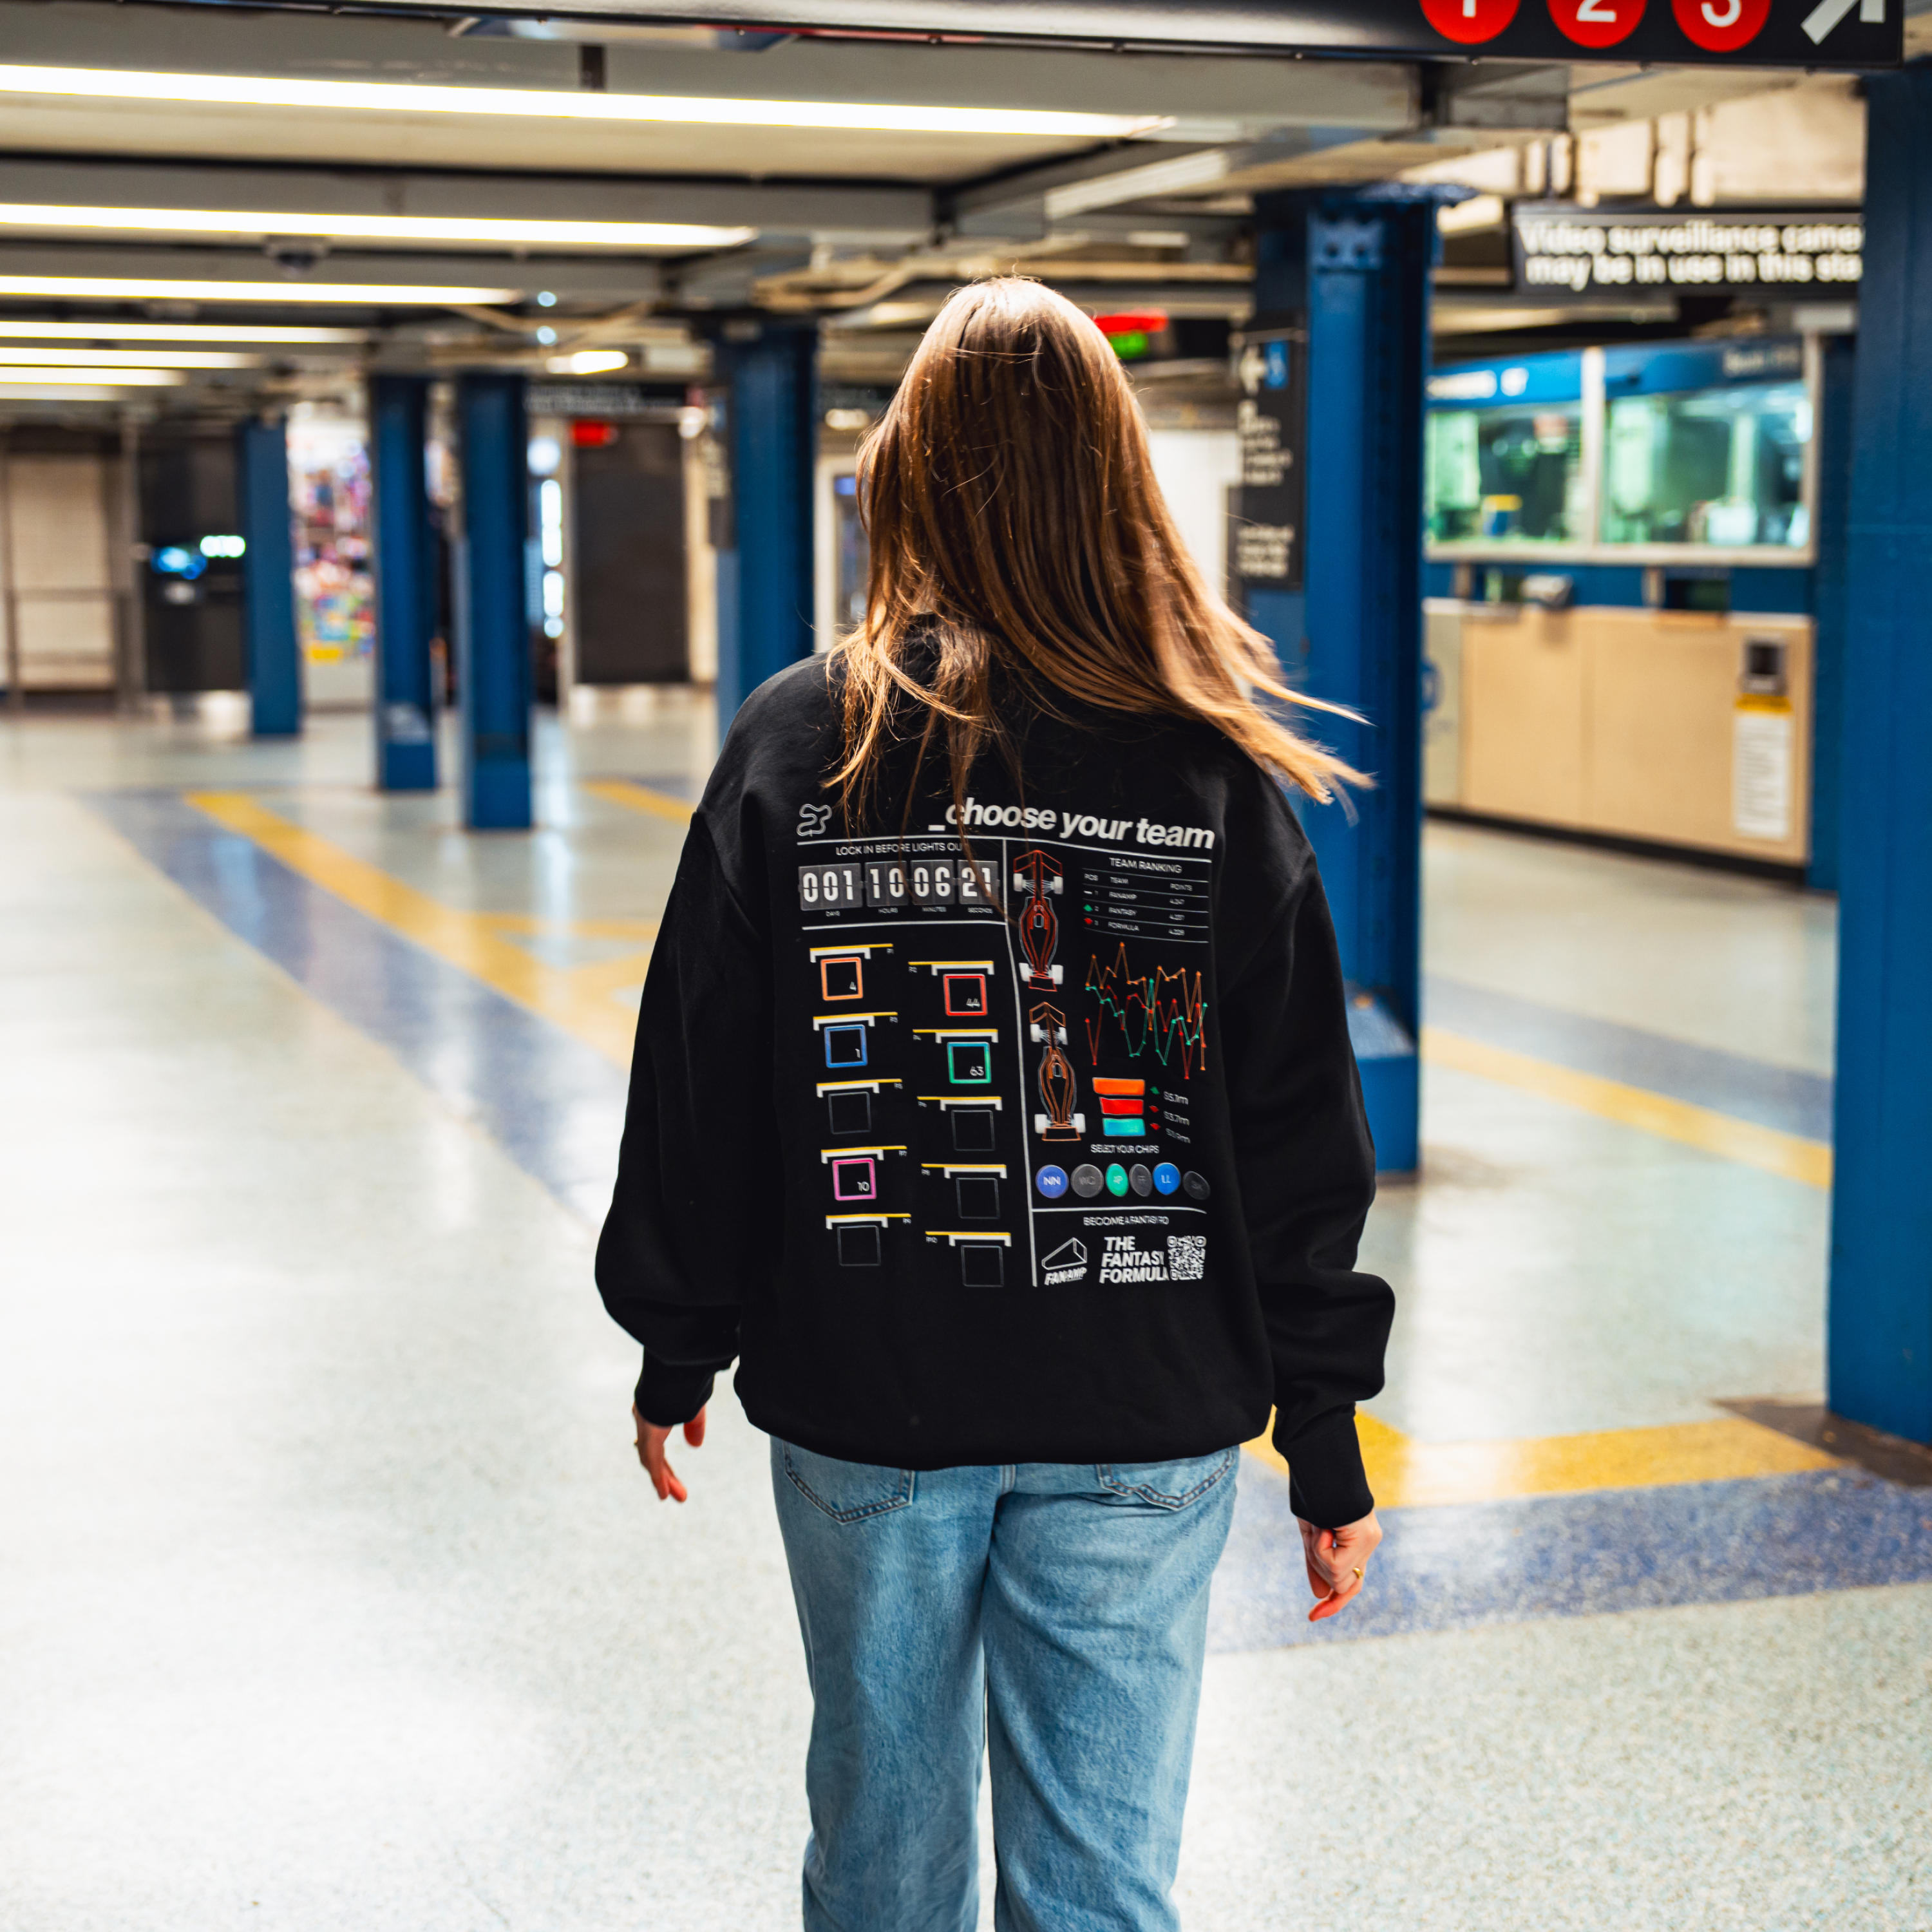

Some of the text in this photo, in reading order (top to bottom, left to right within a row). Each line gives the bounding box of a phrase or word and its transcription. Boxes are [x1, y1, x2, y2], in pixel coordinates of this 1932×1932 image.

[1519, 220, 1607, 255] Video
[1609, 219, 1779, 255] surveillance
[1526, 256, 1590, 292] may
[1593, 253, 1633, 284] be
[1635, 253, 1667, 283] in
[1669, 257, 1724, 283] use
[1725, 252, 1756, 283] in
[1758, 251, 1814, 283] this
[1059, 812, 1132, 840] your
[1136, 818, 1215, 849] team
[835, 842, 965, 856] LOCK IN BEFORE LIGHTS OU
[1109, 857, 1182, 873] TEAM RANKING
[802, 866, 992, 903] 001 10 06 21
[966, 998, 981, 1008] 44
[970, 1065, 985, 1077] 63
[1116, 1144, 1135, 1153] YOUR
[857, 1181, 869, 1191] 10
[1043, 1177, 1061, 1186] NN
[1083, 1217, 1124, 1226] BECOME
[1130, 1215, 1157, 1224] FANTAS
[1104, 1236, 1135, 1251] THE
[1099, 1266, 1170, 1283] FORMULA
